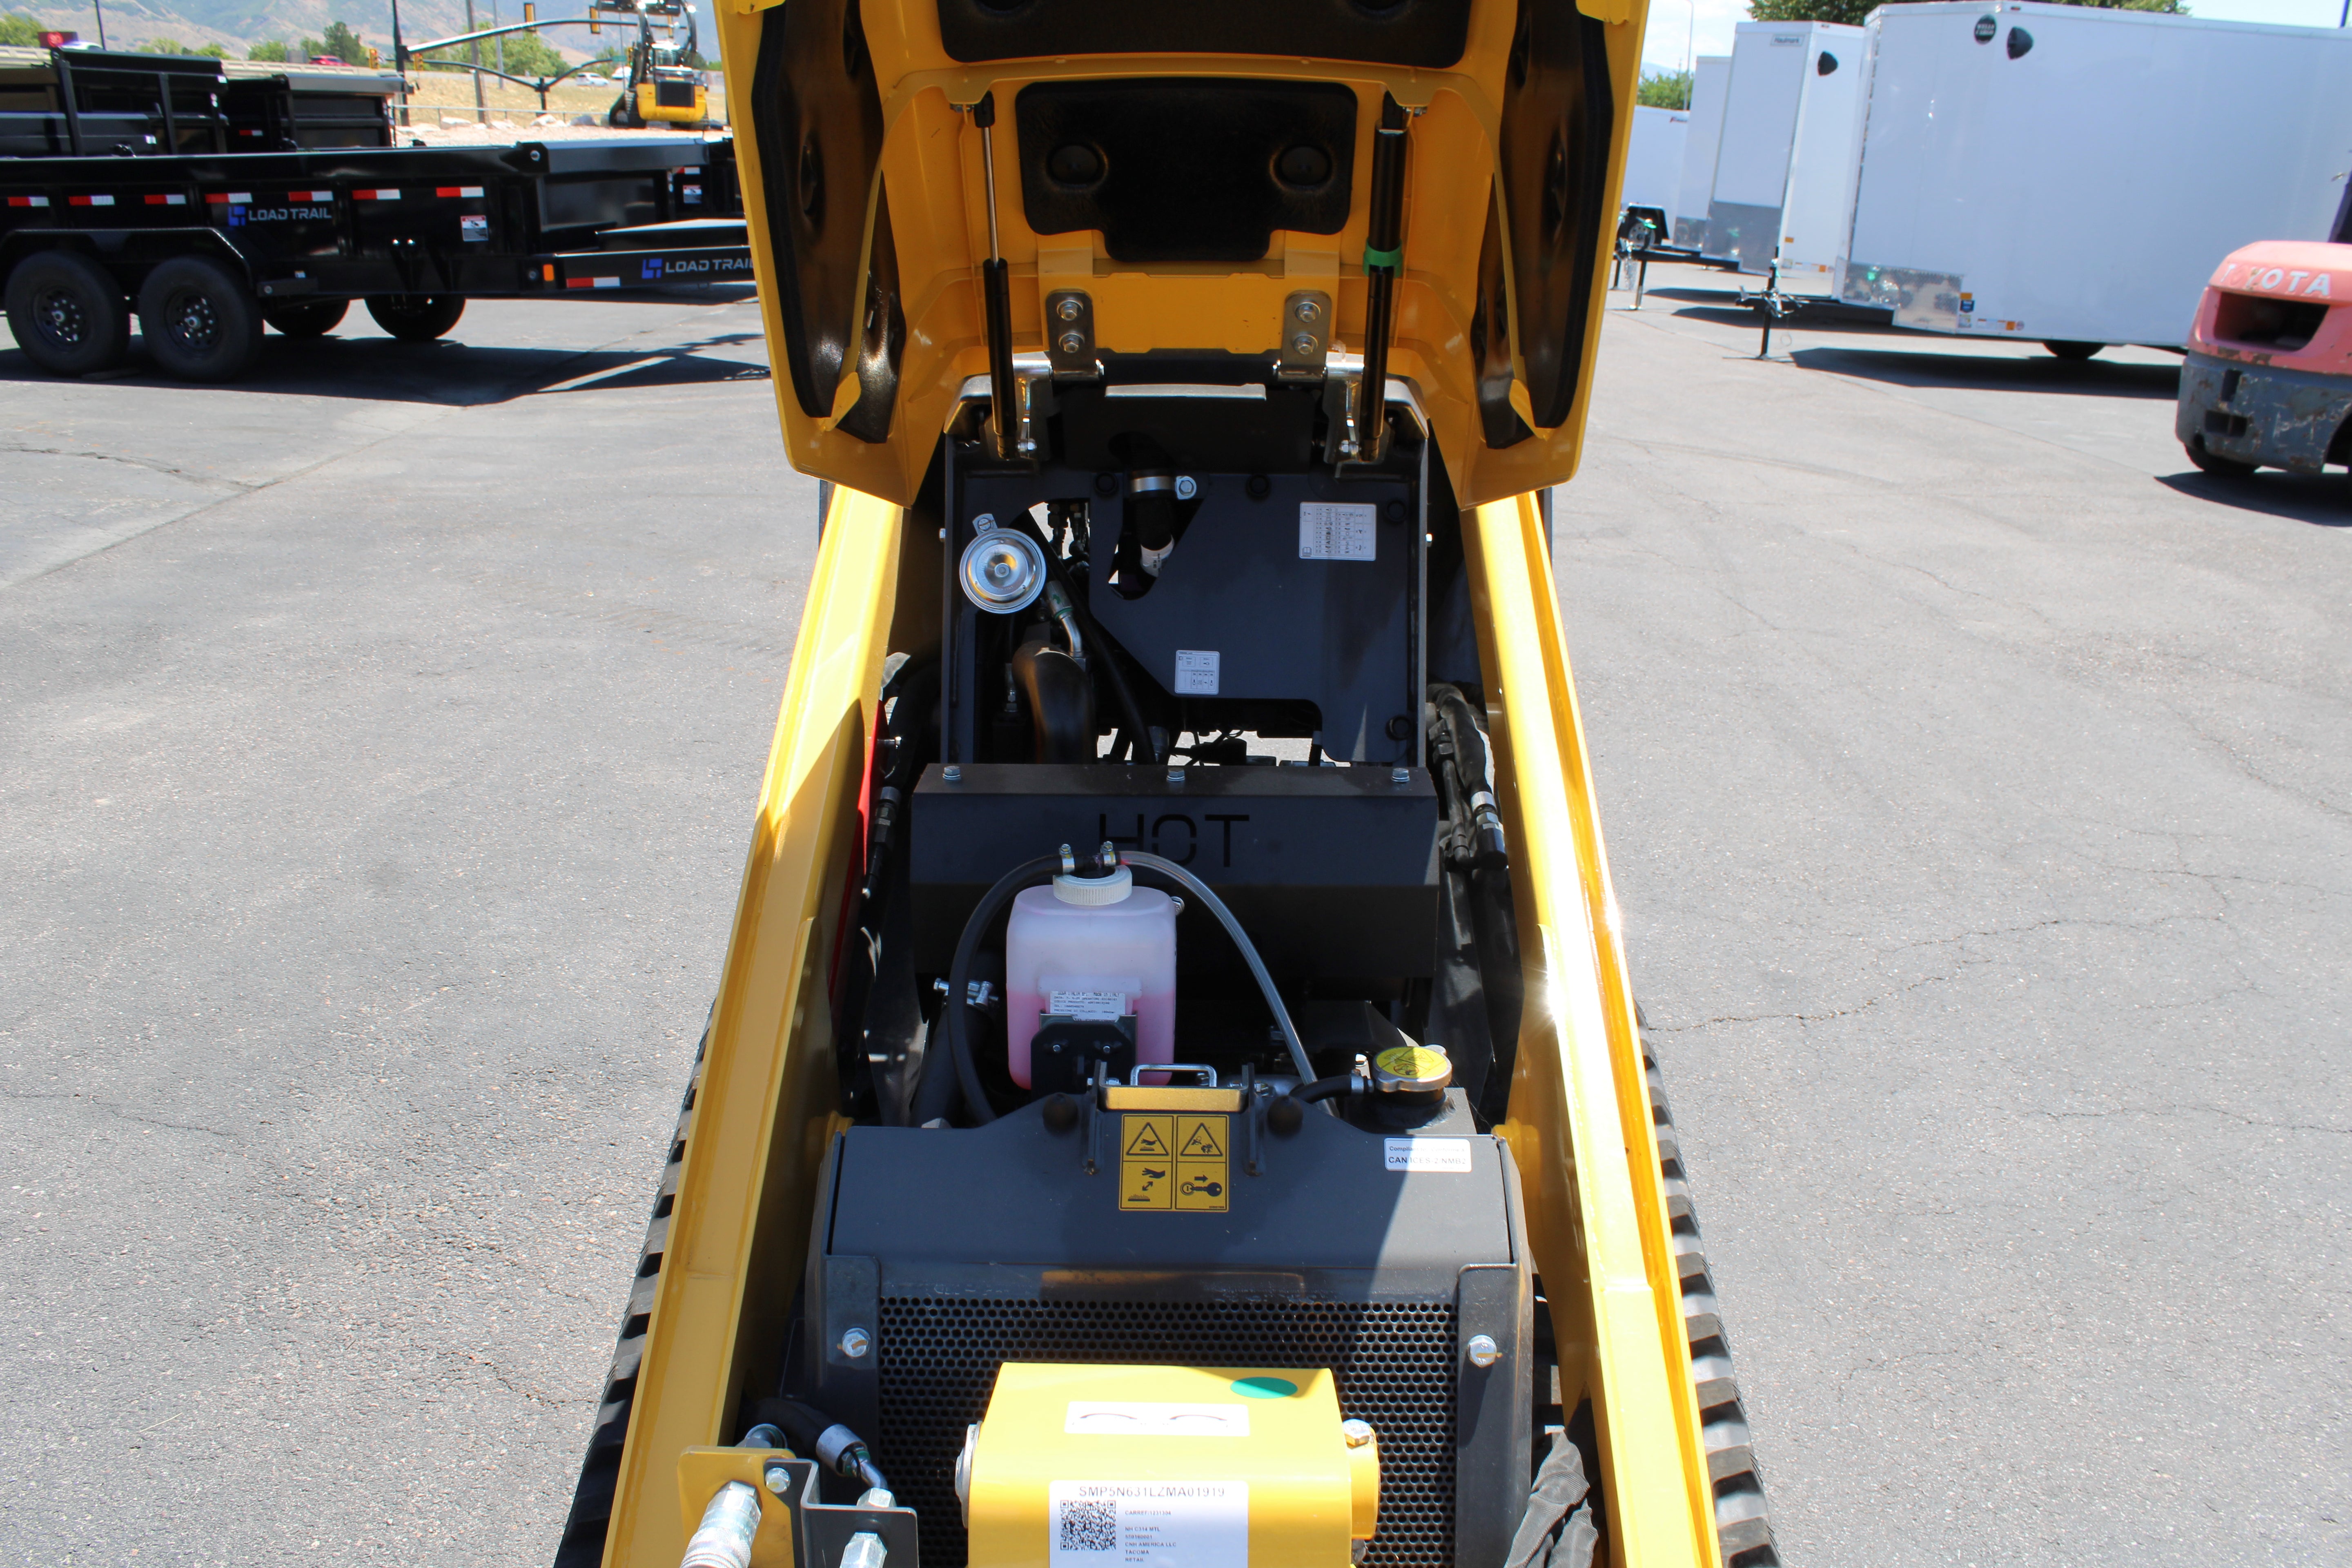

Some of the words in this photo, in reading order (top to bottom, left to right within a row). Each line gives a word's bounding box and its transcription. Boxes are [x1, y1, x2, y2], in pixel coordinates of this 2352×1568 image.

[248, 209, 287, 221] LOAD
[290, 207, 332, 220] TRAIL
[665, 260, 710, 273] LOAD
[2220, 263, 2331, 296] TOYOTA
[1100, 813, 1250, 867] HOT
